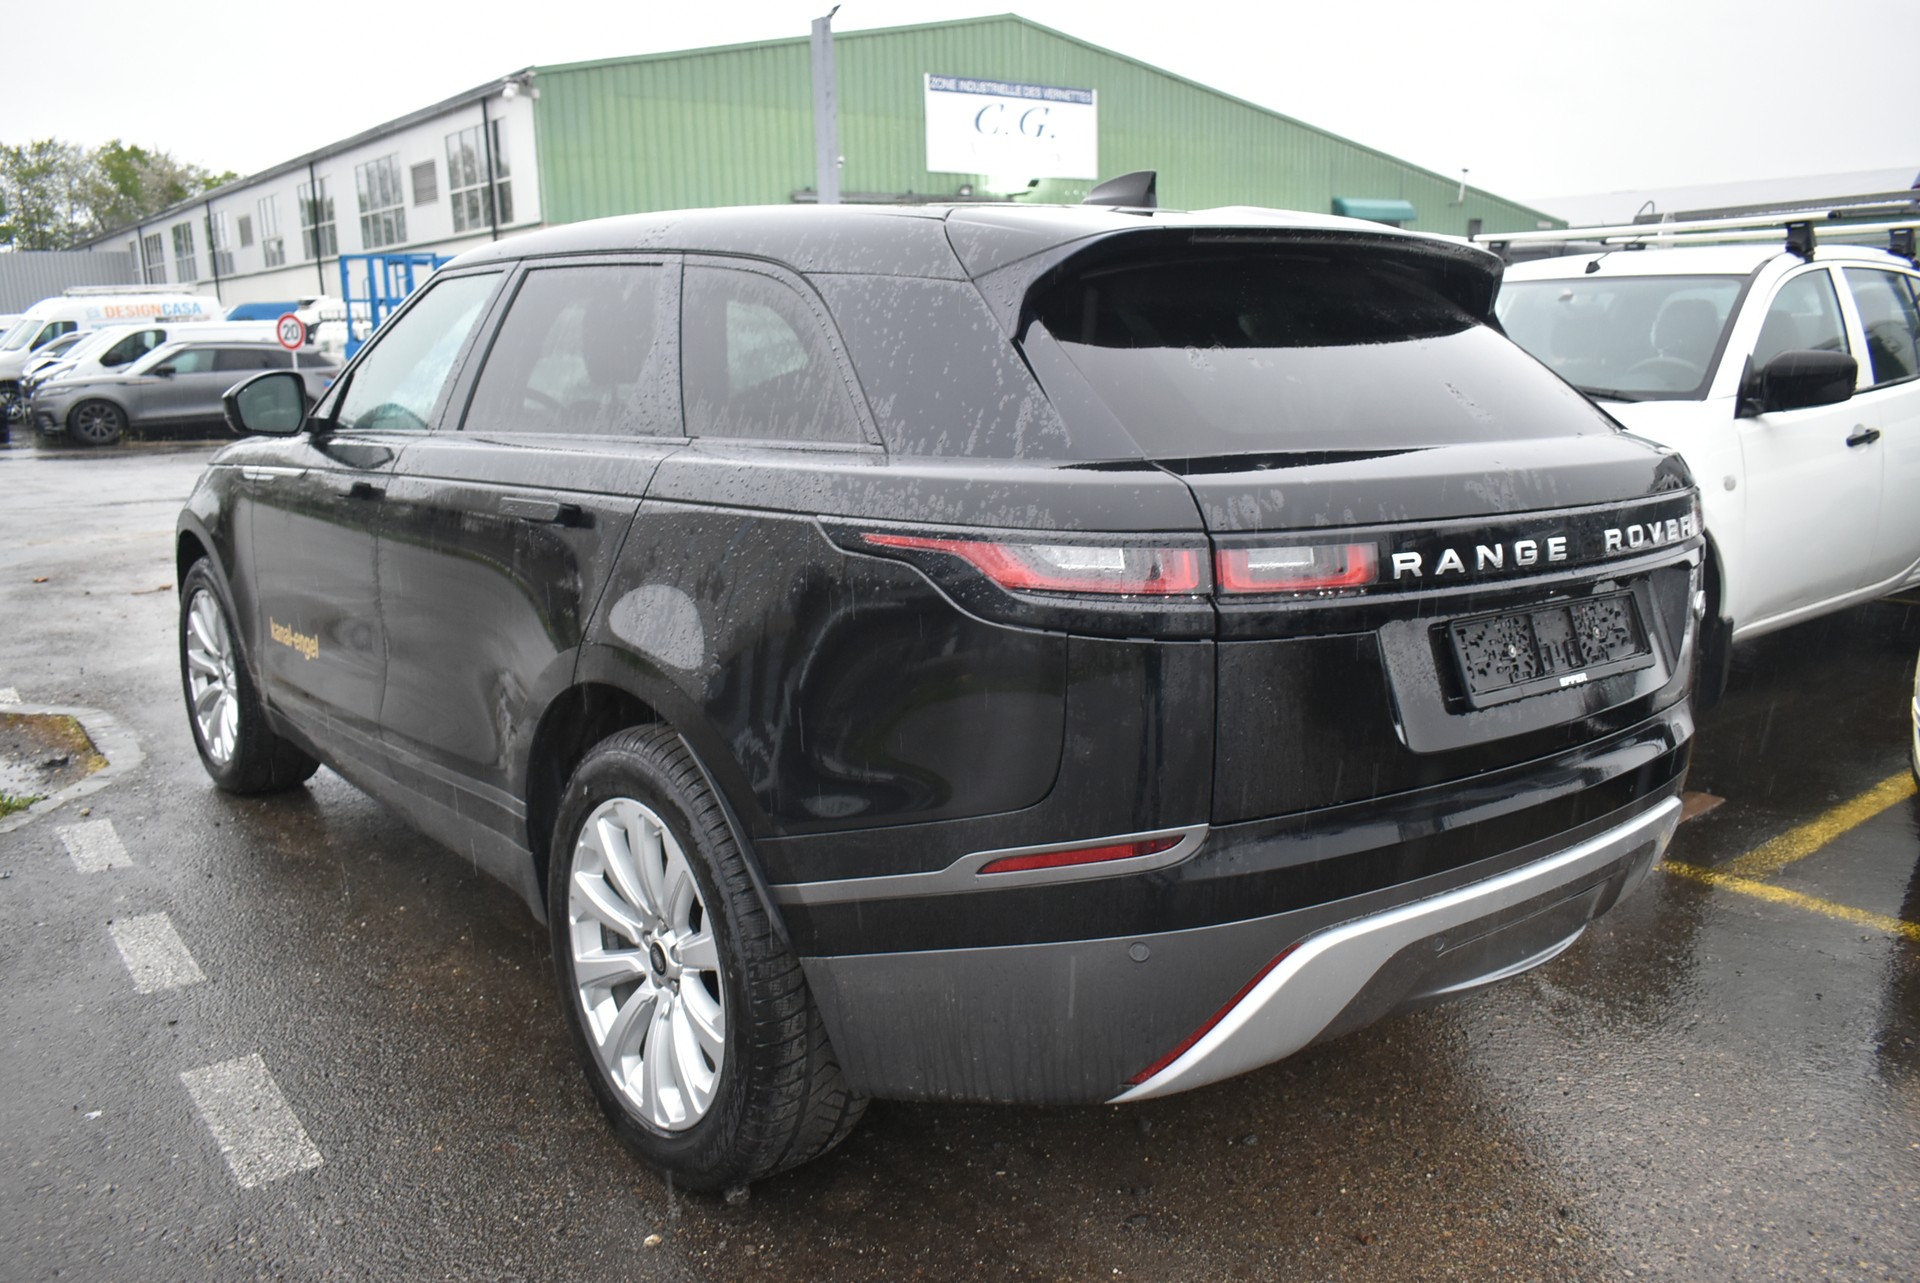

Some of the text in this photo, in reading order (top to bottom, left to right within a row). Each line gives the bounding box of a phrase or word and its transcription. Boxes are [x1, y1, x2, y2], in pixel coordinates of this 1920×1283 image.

[282, 323, 299, 341] 20
[1391, 514, 1692, 580] RANGE ROVER
